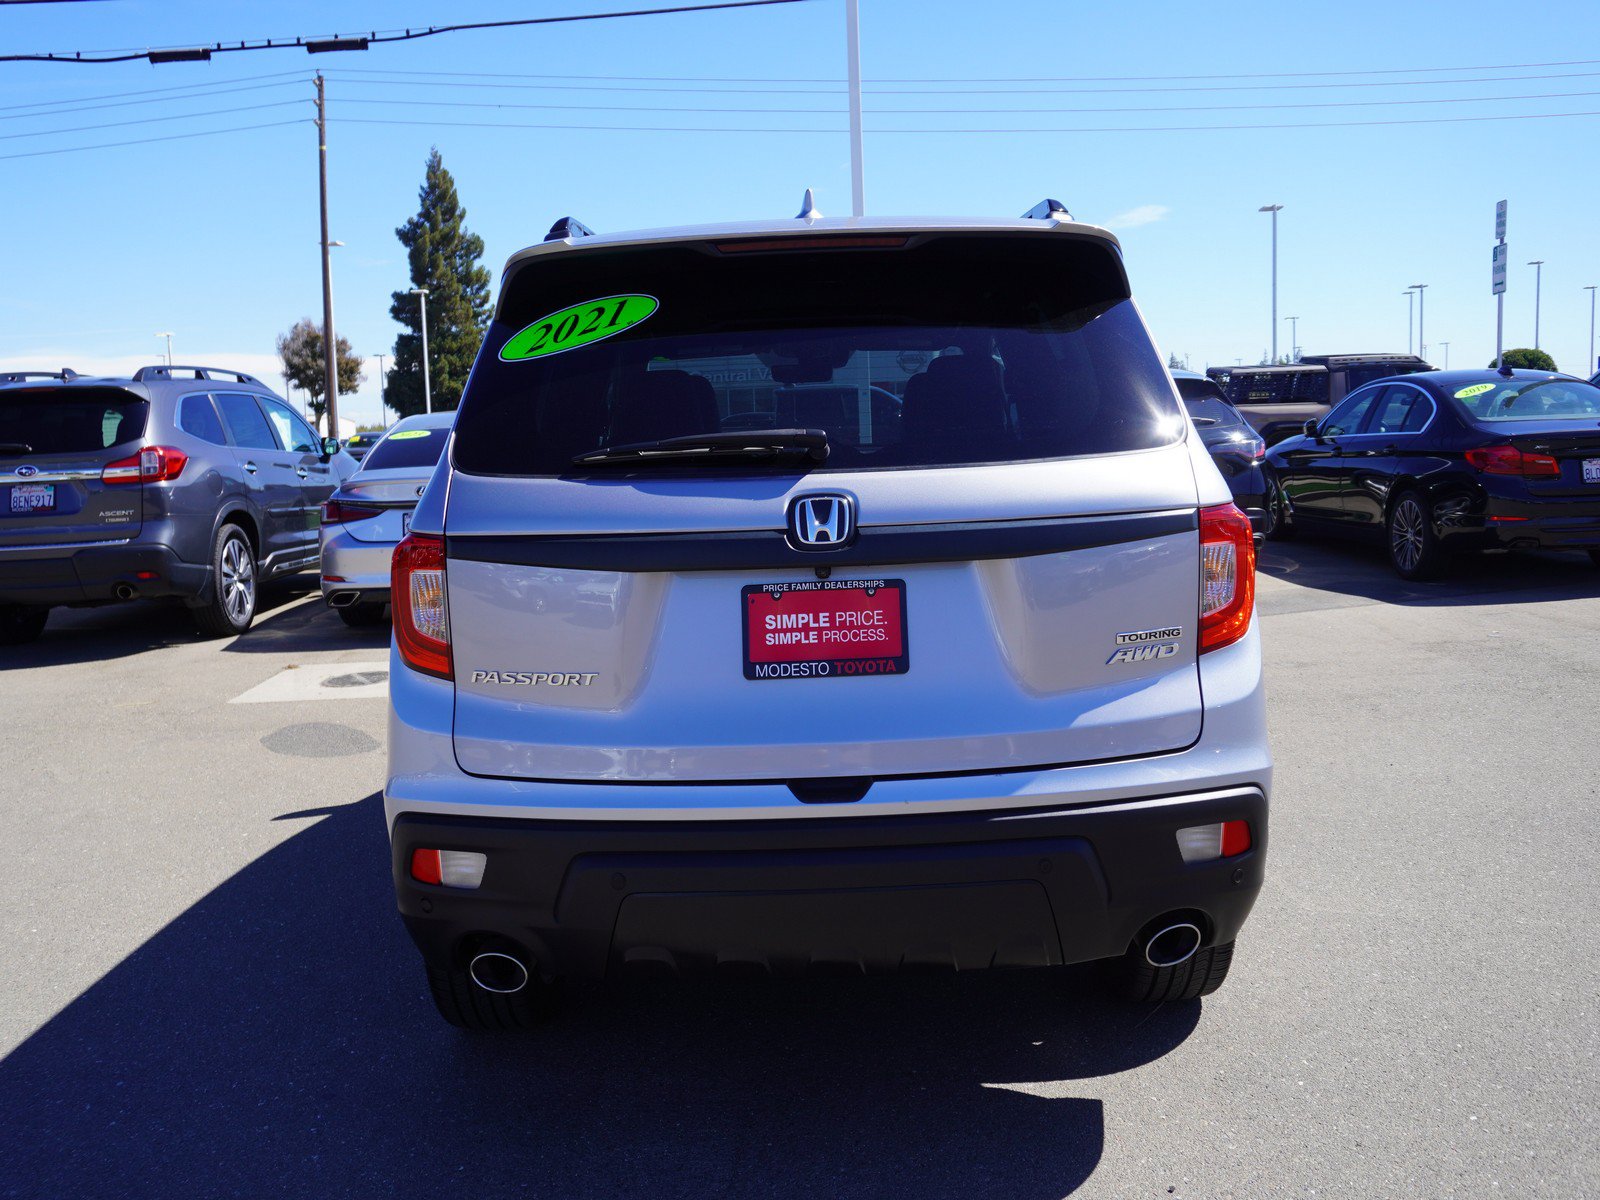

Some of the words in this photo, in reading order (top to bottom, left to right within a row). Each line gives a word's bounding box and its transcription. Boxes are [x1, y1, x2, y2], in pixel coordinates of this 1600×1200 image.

[524, 299, 628, 354] 2021
[12, 494, 53, 509] 8ENE917
[99, 509, 134, 517] ASCENT
[763, 584, 789, 592] PRICE
[792, 582, 821, 591] FAMILY
[825, 580, 885, 589] DEALERSHIPS
[765, 613, 830, 629] SIMPLE
[836, 610, 888, 627] PRICE.
[765, 631, 818, 645] SIMPLE
[823, 629, 889, 643] PROCESS.
[1118, 628, 1181, 642] TOURING
[1105, 642, 1180, 665] AWD
[755, 662, 829, 678] MODESTO
[834, 660, 896, 674] TOYOTA
[471, 670, 600, 686] PASSPORT
